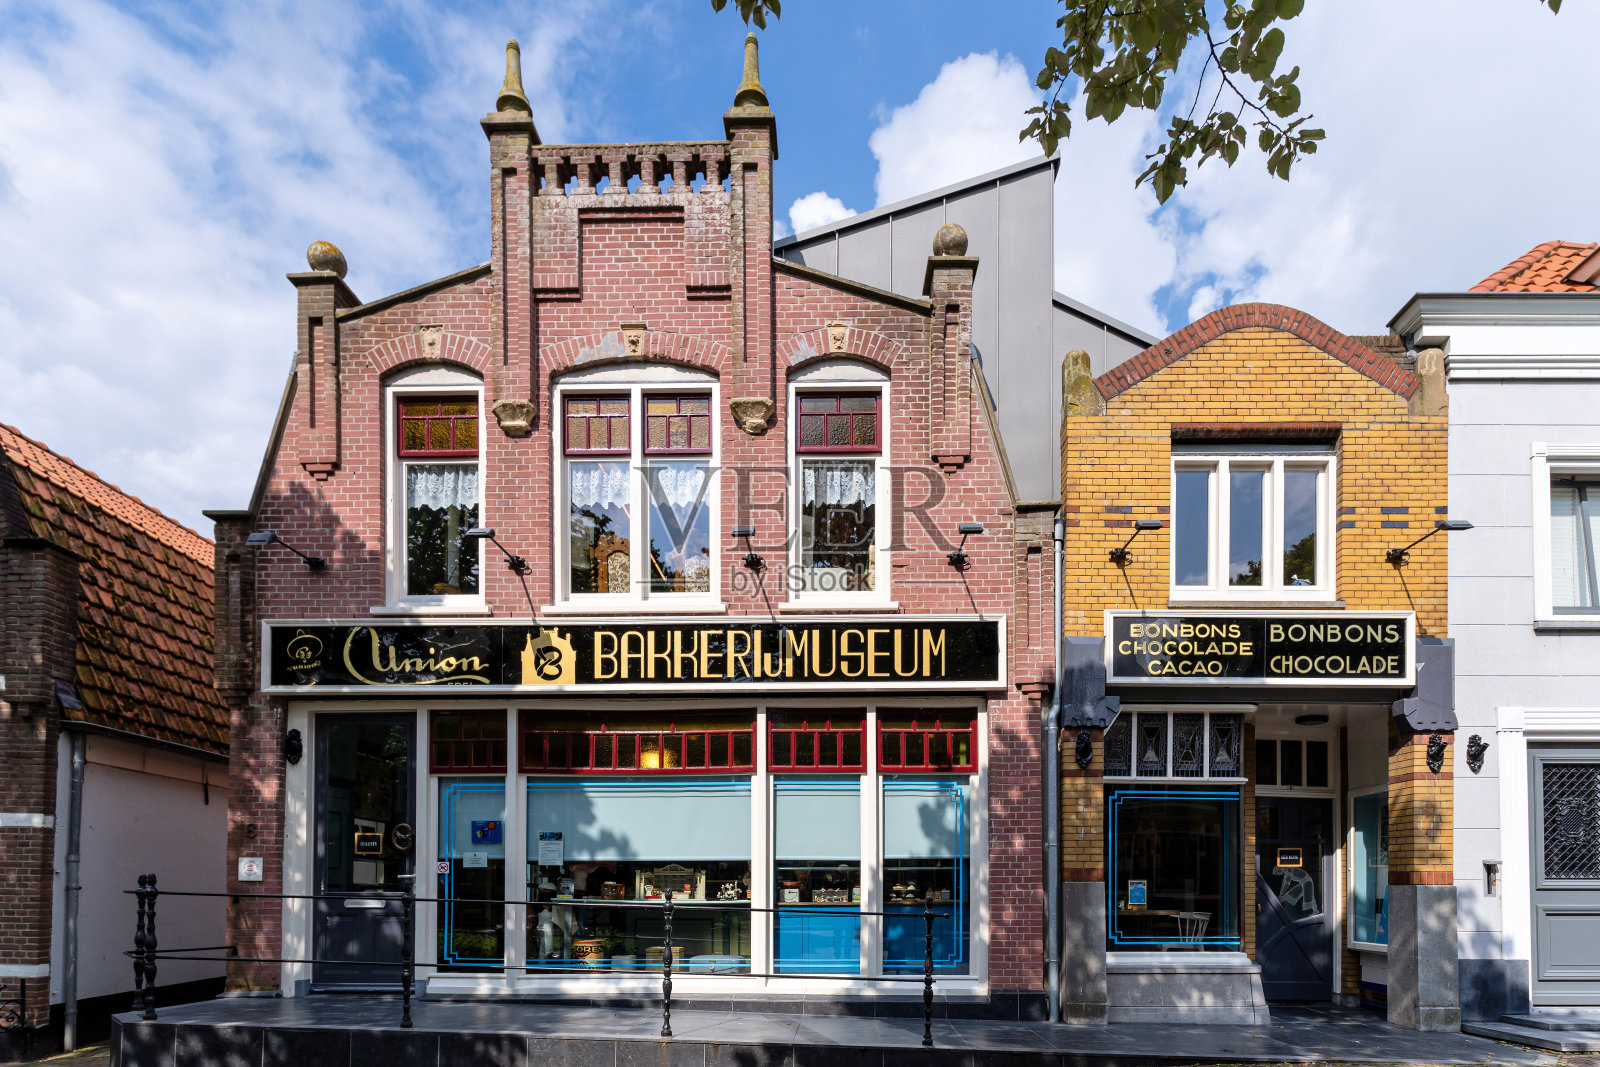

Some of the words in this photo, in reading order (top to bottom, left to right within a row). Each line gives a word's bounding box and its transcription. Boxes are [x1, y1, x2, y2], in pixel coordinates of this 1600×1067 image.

[1129, 623, 1241, 638] BONBONS
[1270, 624, 1400, 643] BONBONS
[343, 626, 490, 685] Union
[594, 628, 945, 679] BAKKERIJMUSEUM
[1118, 640, 1253, 655] CHOCOLADE
[1147, 660, 1223, 675] CACAO
[1270, 655, 1399, 674] CHOCOLADE
[247, 824, 257, 838] 8
